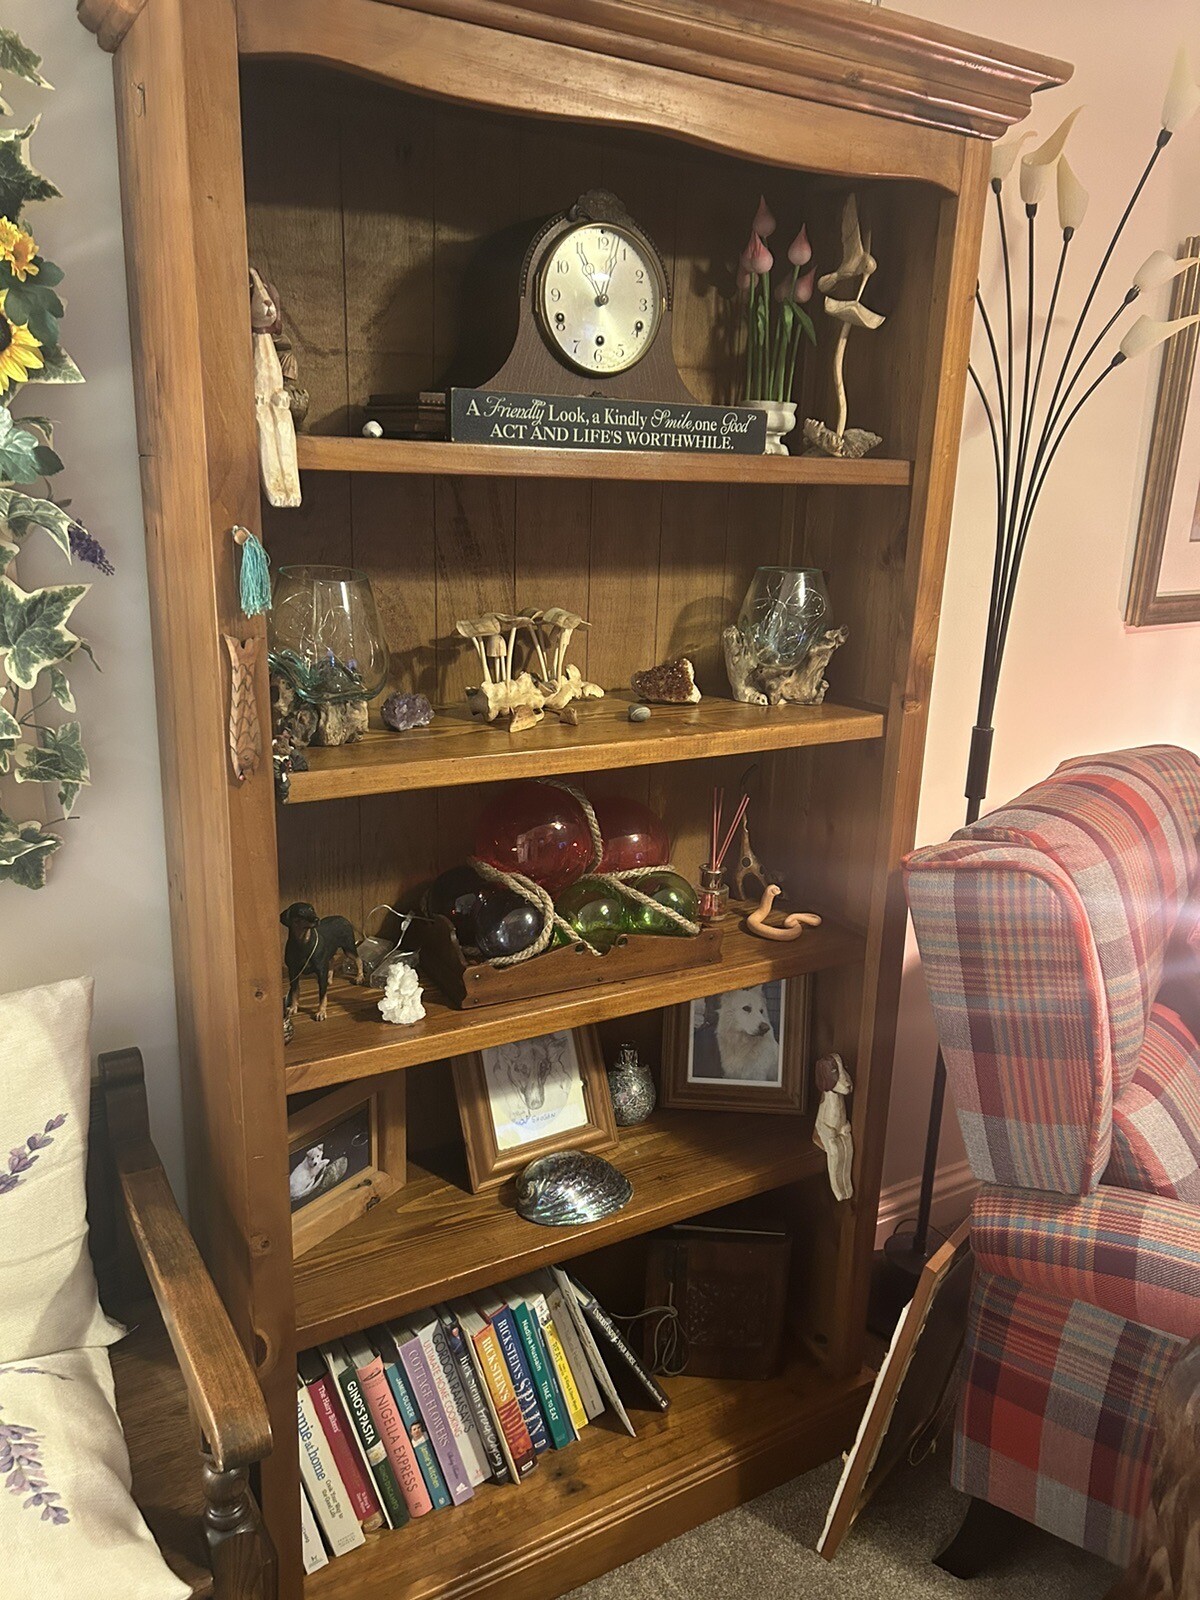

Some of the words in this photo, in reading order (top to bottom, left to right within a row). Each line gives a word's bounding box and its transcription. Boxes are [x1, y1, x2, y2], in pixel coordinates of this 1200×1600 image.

[598, 237, 609, 249] 12
[623, 249, 626, 261] 1
[556, 260, 569, 274] 10
[636, 270, 643, 284] 2
[551, 288, 560, 302] 9
[639, 299, 647, 312] 3
[573, 340, 581, 353] 7
[594, 351, 602, 362] 6
[616, 344, 624, 357] 5
[466, 399, 481, 416] A
[483, 397, 546, 425] Friendly
[548, 404, 589, 425] Look,
[592, 413, 600, 424] a
[604, 408, 647, 429] Kindly
[721, 412, 756, 434] Good
[490, 423, 527, 439] ACT
[531, 425, 569, 443] AND
[573, 429, 622, 445] LIFE'S
[627, 432, 735, 450] WORTHWHILE.
[497, 1319, 513, 1344] RICK
[481, 1336, 498, 1364] RICK
[521, 1319, 533, 1344] Nadiya
[529, 1344, 542, 1371] Hussain
[459, 1355, 474, 1378] Rick
[504, 1343, 524, 1379] STEIN'S
[318, 1385, 327, 1398] The
[422, 1340, 441, 1376] ULTIMATE
[435, 1376, 449, 1400] HOME
[442, 1400, 462, 1438] COOKING
[430, 1332, 457, 1383] GORDON
[448, 1382, 474, 1434] RAMSAY'S
[489, 1362, 510, 1401] STEIN'S
[541, 1380, 551, 1399] TIME
[322, 1397, 333, 1414] Hairy
[395, 1376, 408, 1396] JAMIE
[402, 1396, 416, 1418] OLIVER
[407, 1349, 434, 1400] COTTAGE
[425, 1399, 450, 1447] FLOWERS
[511, 1377, 545, 1436] SPAIN
[547, 1399, 553, 1408] TO
[346, 1380, 367, 1417] GINO'S
[358, 1414, 376, 1444] PASTA
[495, 1397, 527, 1445] INDIA
[549, 1407, 558, 1421] EAT
[304, 1441, 314, 1452] at
[374, 1394, 401, 1445] NIGELLA
[393, 1445, 419, 1493] EXPRESS
[307, 1448, 329, 1481] home
